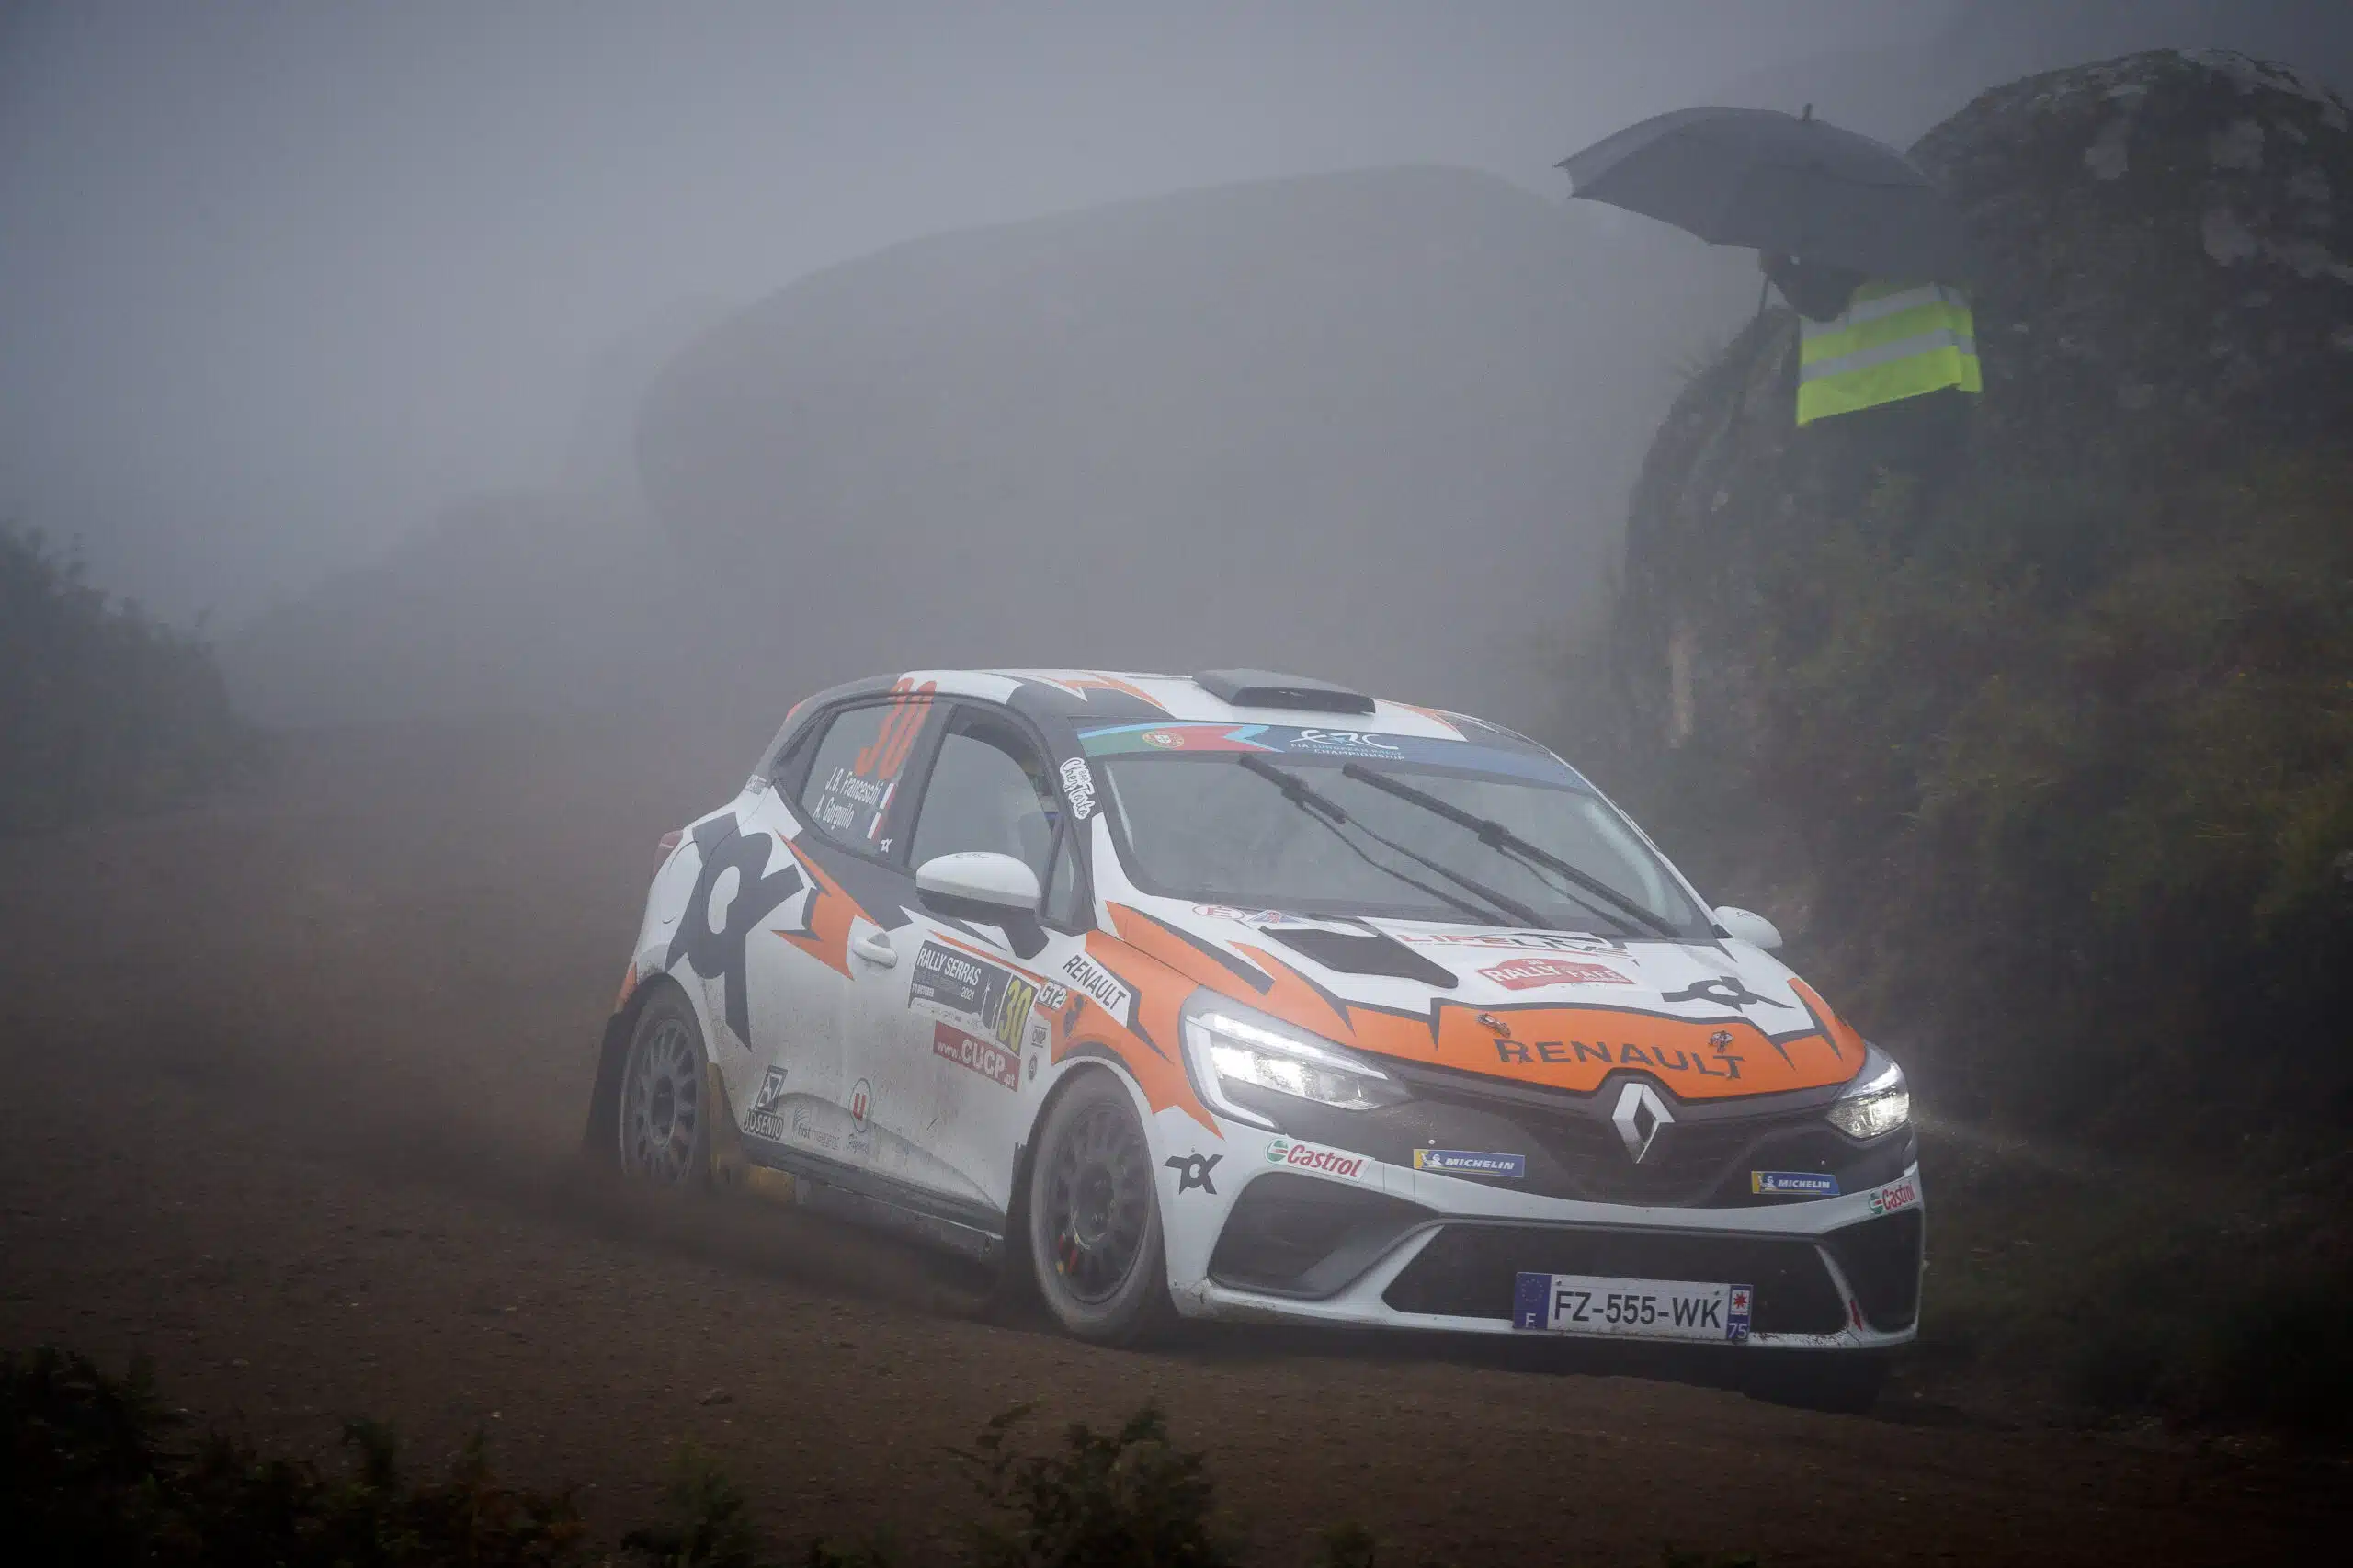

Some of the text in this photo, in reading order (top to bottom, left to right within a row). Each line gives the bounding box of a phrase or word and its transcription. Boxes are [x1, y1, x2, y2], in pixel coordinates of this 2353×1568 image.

[1314, 748, 1405, 761] CHAMPIONSHIP
[840, 771, 885, 806] Franceschi
[917, 948, 947, 972] RALLY
[944, 956, 982, 986] SERRAS
[1063, 954, 1127, 1010] RENAULT
[1483, 965, 1562, 983] RALLY
[1040, 983, 1066, 1009] GT2
[999, 978, 1032, 1051] 30
[1493, 1038, 1745, 1080] RENAULT
[1287, 1144, 1364, 1178] Castrol
[1444, 1158, 1516, 1171] MICHELIN
[1778, 1179, 1832, 1189] MICHELIN
[1882, 1180, 1917, 1210] Castrol
[1525, 1290, 1747, 1340] F FZ-555-WK 75
